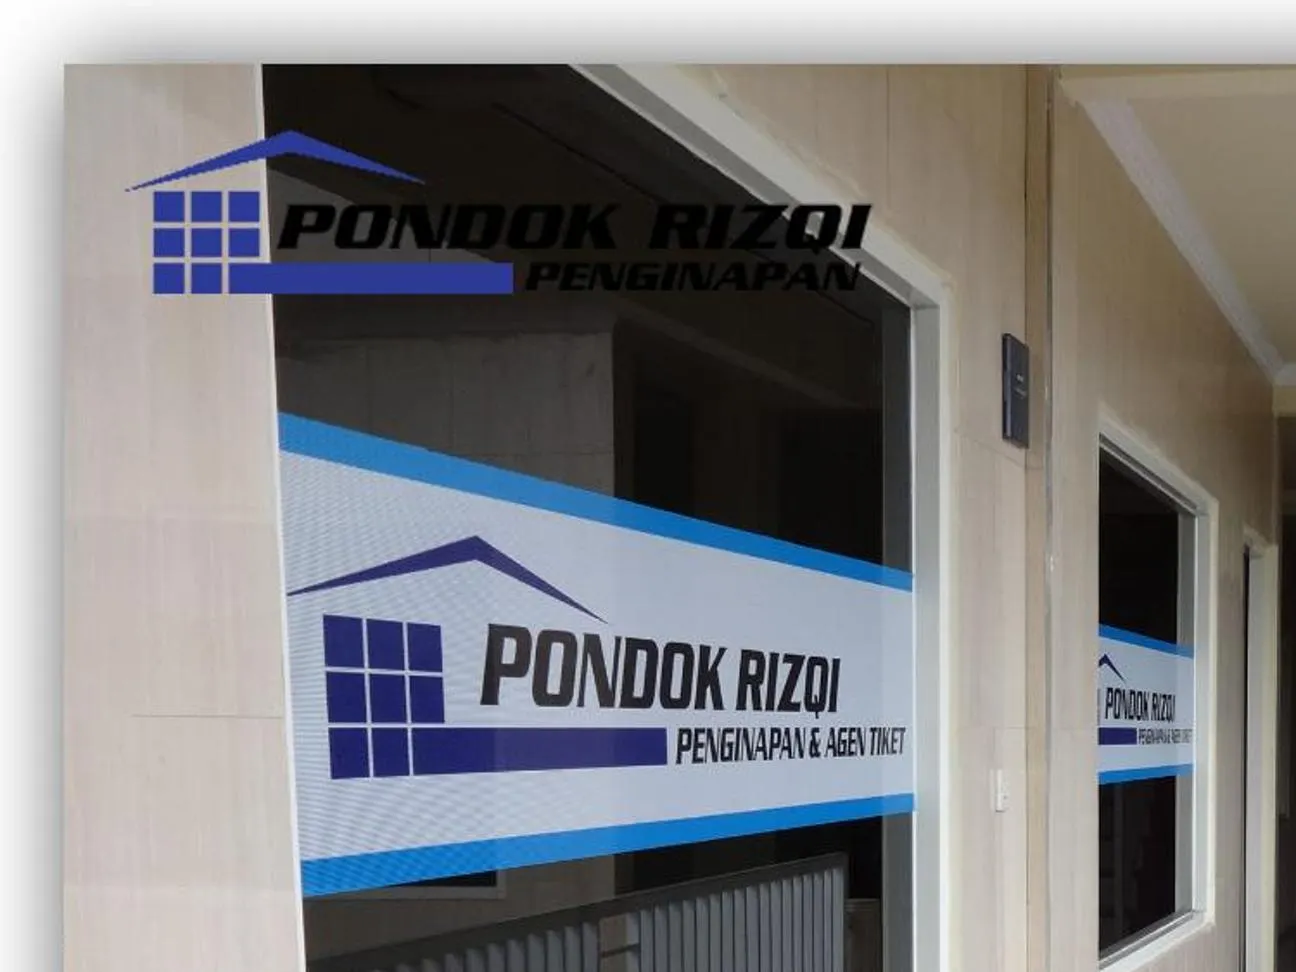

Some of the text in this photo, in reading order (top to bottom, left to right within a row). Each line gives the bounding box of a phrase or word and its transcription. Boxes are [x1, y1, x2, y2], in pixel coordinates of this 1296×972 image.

[480, 623, 841, 719] PONDOK RIZQI
[675, 727, 907, 765] PENGINAPAN & AGEN TIKET
